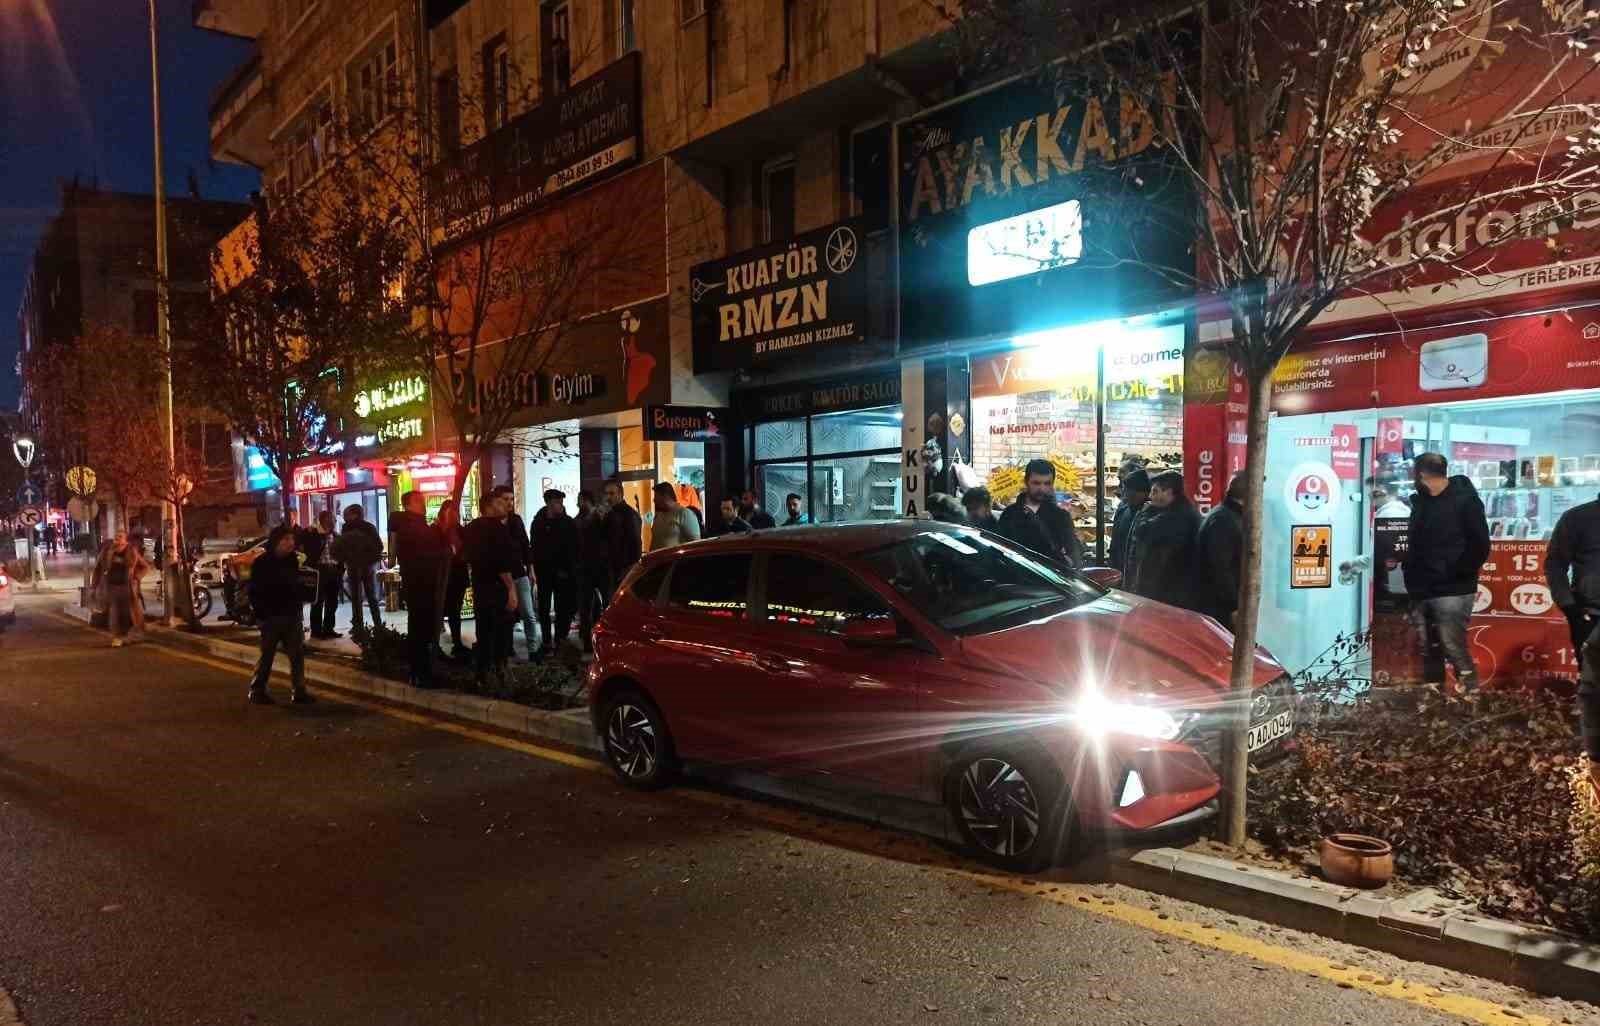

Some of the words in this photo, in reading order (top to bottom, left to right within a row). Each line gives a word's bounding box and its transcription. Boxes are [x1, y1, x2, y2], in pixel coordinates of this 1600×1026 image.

[726, 243, 818, 295] KUAFÖR
[1518, 264, 1600, 288] TERLEMEZ
[719, 279, 829, 342] RMZN
[755, 341, 768, 353] BY
[768, 331, 814, 351] RAMAZAN
[815, 323, 855, 342] KIZMAZ
[1335, 349, 1387, 364] internetini
[551, 372, 593, 406] Giyim
[1512, 554, 1539, 572] 15
